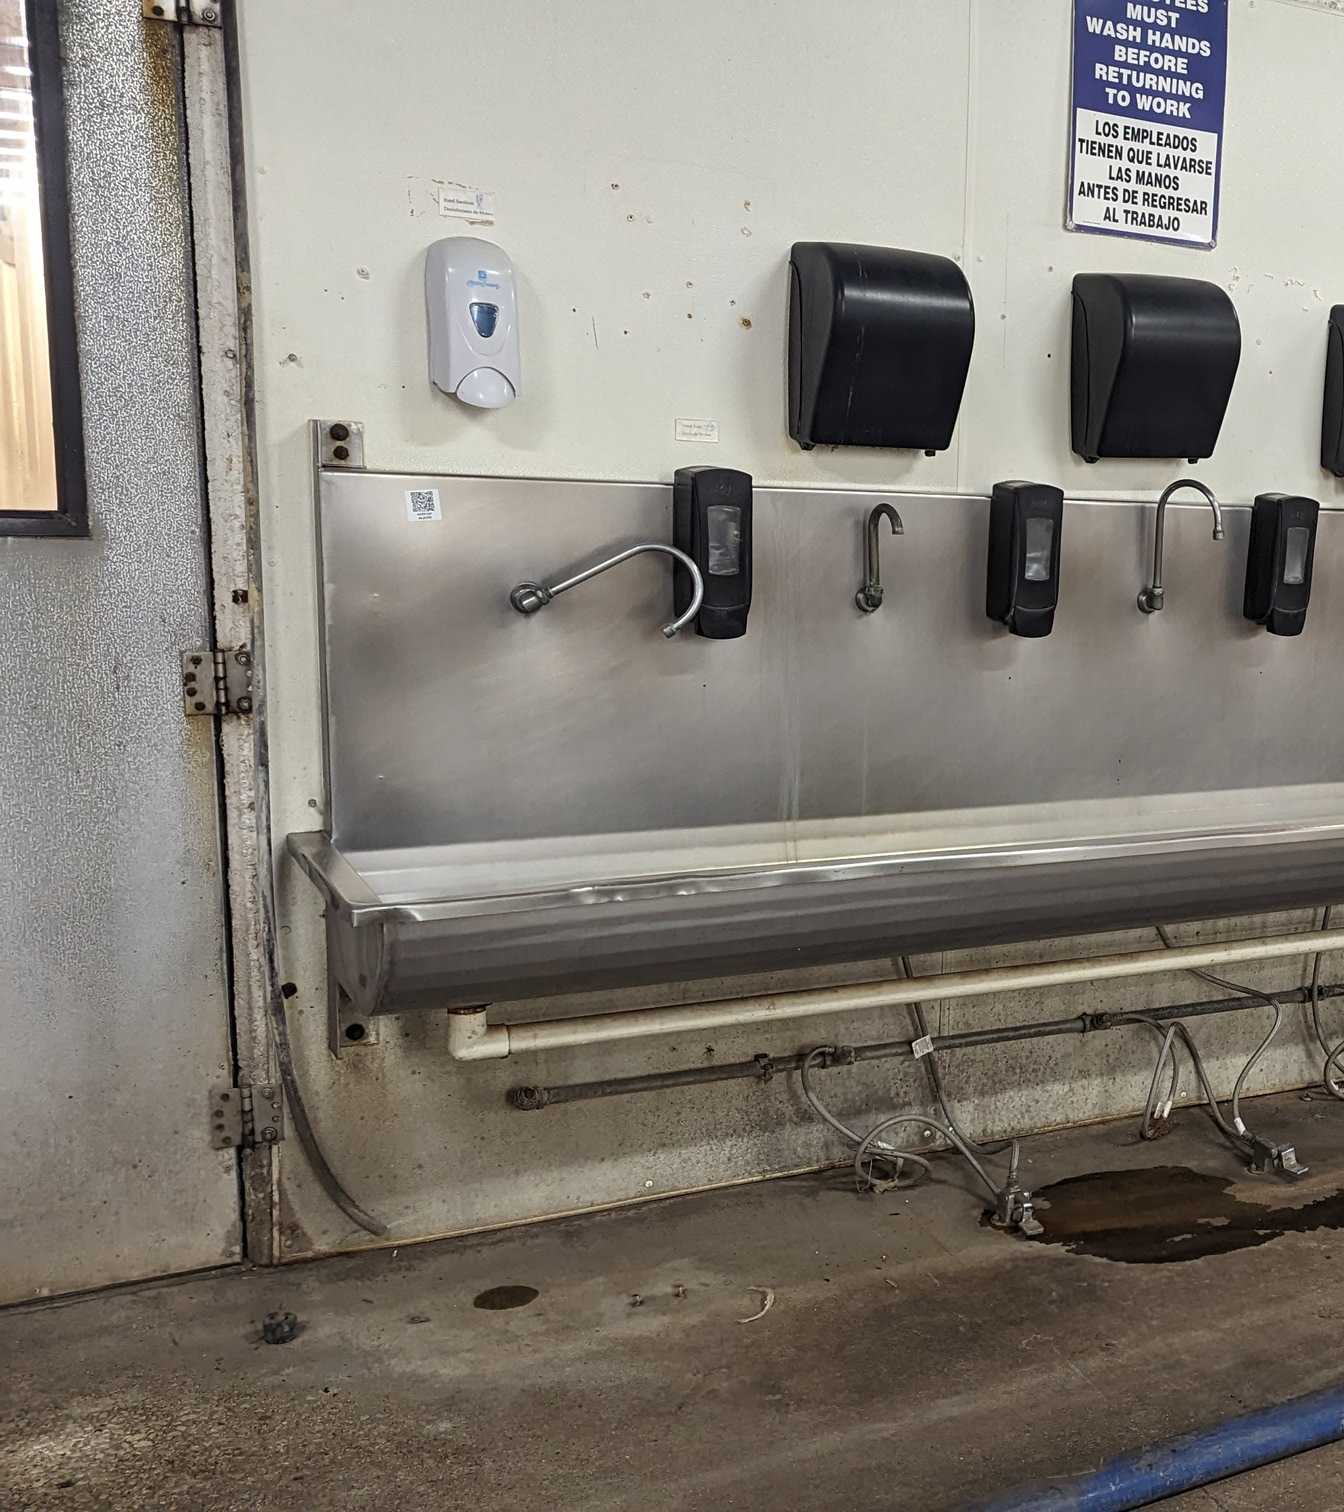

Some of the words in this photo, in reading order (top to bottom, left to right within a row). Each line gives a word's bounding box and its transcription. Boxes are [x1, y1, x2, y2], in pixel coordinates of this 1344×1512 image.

[1126, 3, 1180, 28] MUST
[1086, 16, 1141, 43] WASH
[1147, 29, 1211, 57] HANDS
[1114, 44, 1188, 74] BEFORE
[1094, 63, 1204, 100] RETURNING
[1105, 88, 1131, 107] TO
[1136, 93, 1191, 119] WORK
[1095, 120, 1119, 139] LOS
[1123, 125, 1197, 153] EMPLEADOS
[1078, 138, 1123, 161] TIENEN
[1127, 148, 1152, 166] QUE
[1157, 153, 1213, 176] LAVARSE
[1109, 165, 1131, 183] LAS
[1136, 170, 1180, 191] MANOS
[1078, 181, 1118, 202] ANTES
[1123, 190, 1138, 205] DE
[1143, 194, 1208, 216] REGRESAR
[1103, 207, 1119, 223] AL
[1123, 209, 1180, 232] TRABAJO
